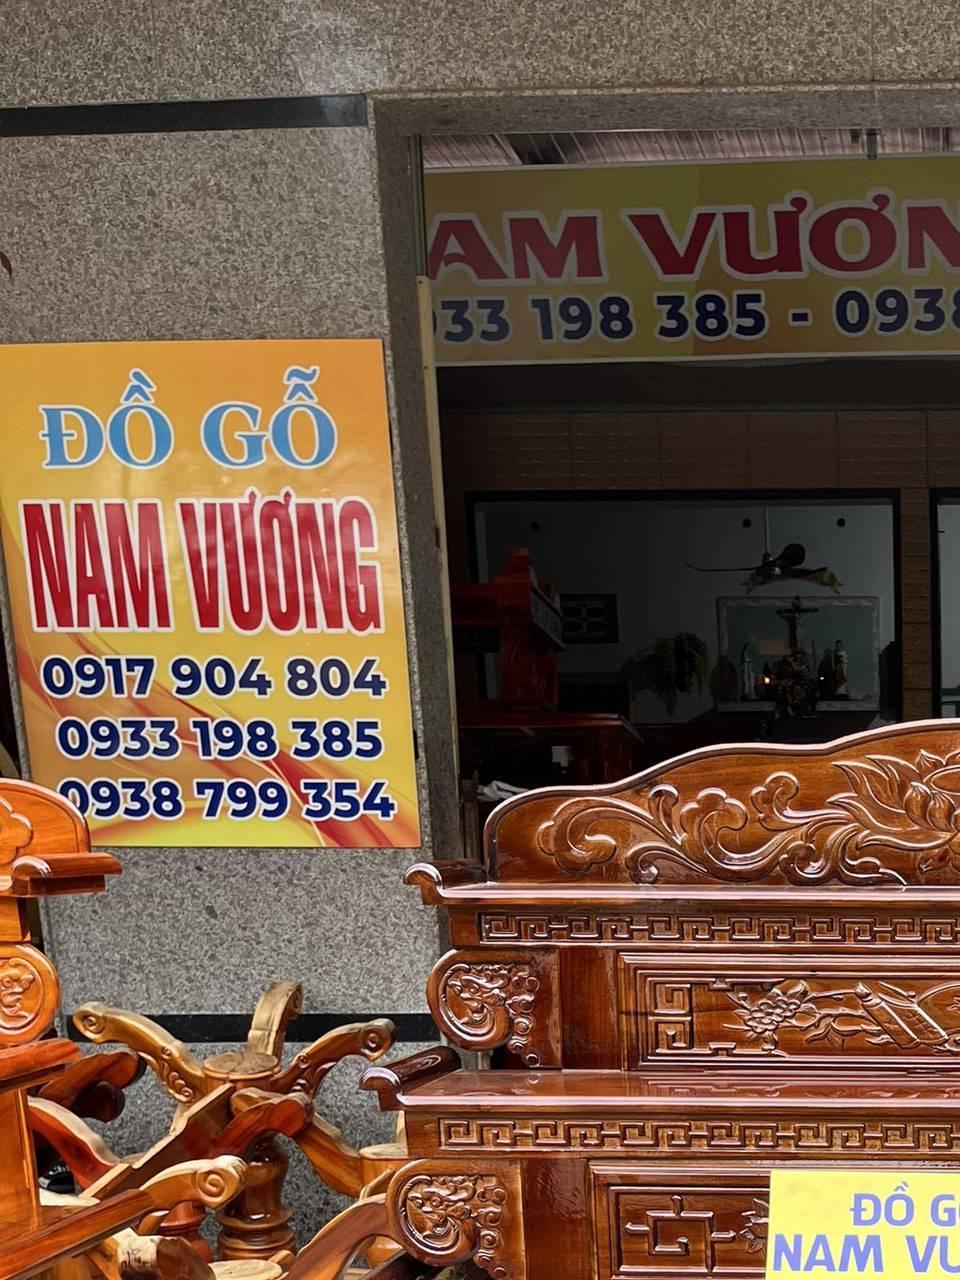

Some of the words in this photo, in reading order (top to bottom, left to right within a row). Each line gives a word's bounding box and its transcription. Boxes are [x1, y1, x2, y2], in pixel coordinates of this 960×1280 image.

[431, 297, 510, 342] 33
[531, 296, 634, 341] 198
[656, 292, 767, 338] 385
[791, 311, 810, 323] -
[41, 370, 173, 467] ĐỒ
[202, 367, 337, 467] GỖ
[22, 502, 172, 629] NAM
[179, 490, 382, 631] VƯƠNG
[42, 657, 155, 696] 0917
[172, 658, 272, 697] 904
[286, 658, 387, 696] 804
[58, 719, 179, 758] 0933
[191, 720, 277, 758] 198
[291, 720, 383, 758] 385
[59, 780, 183, 818] 0938
[196, 781, 288, 818] 799
[303, 780, 395, 818] 354
[849, 1181, 915, 1227] ĐỒ
[772, 1233, 884, 1273] NAM
